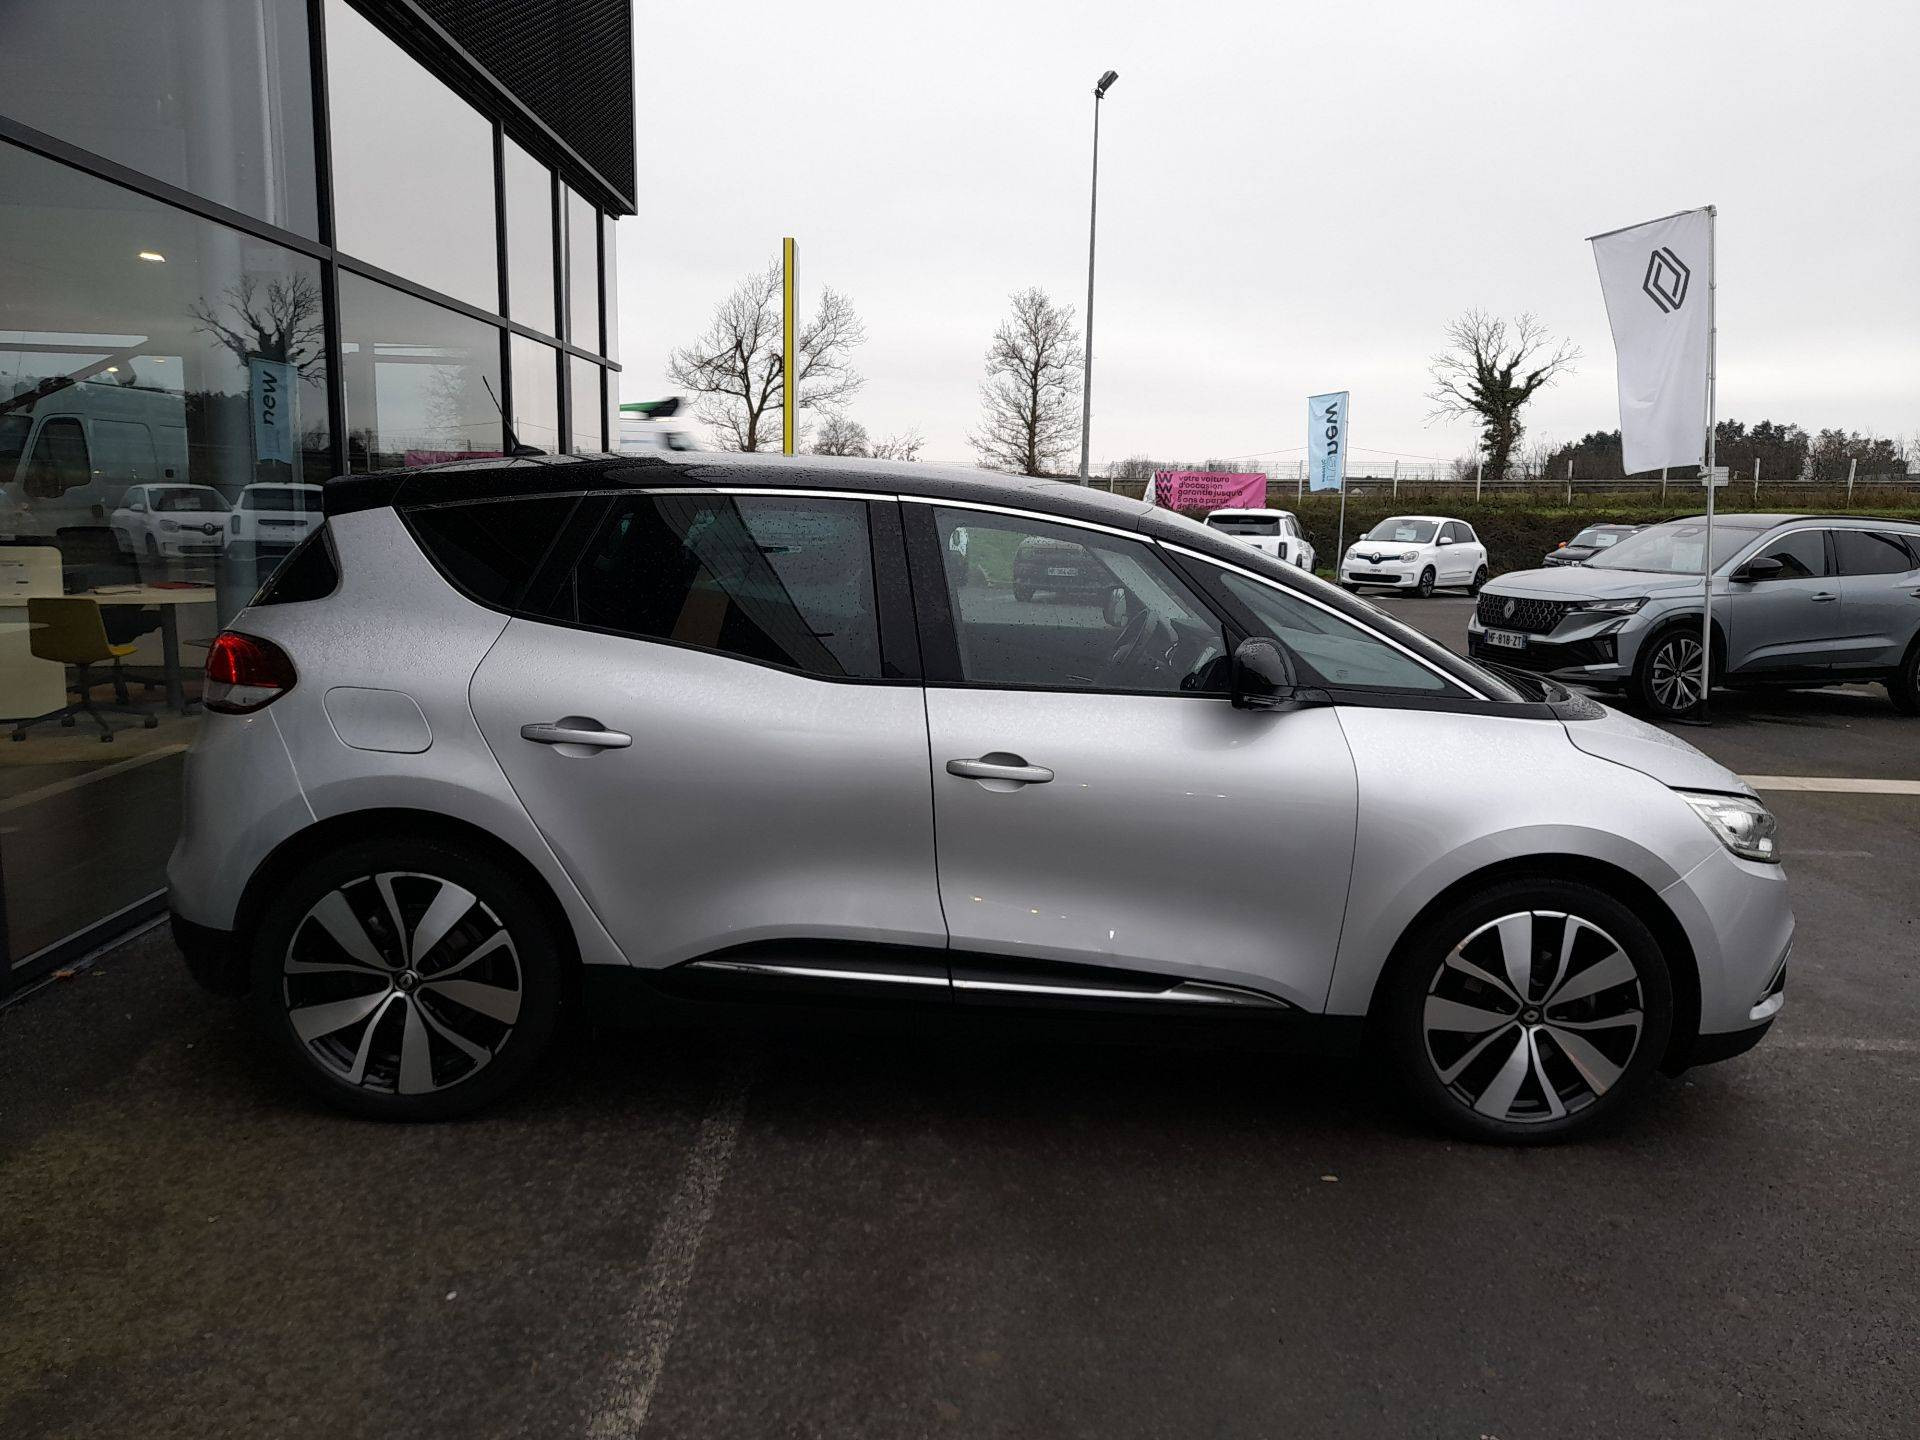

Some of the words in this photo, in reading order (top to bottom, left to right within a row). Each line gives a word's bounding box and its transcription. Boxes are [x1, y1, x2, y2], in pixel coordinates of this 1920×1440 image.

[1200, 475, 1230, 483] voiture
[1178, 481, 1223, 489] d'occasion
[1177, 489, 1212, 497] garantie
[1205, 497, 1229, 505] partir
